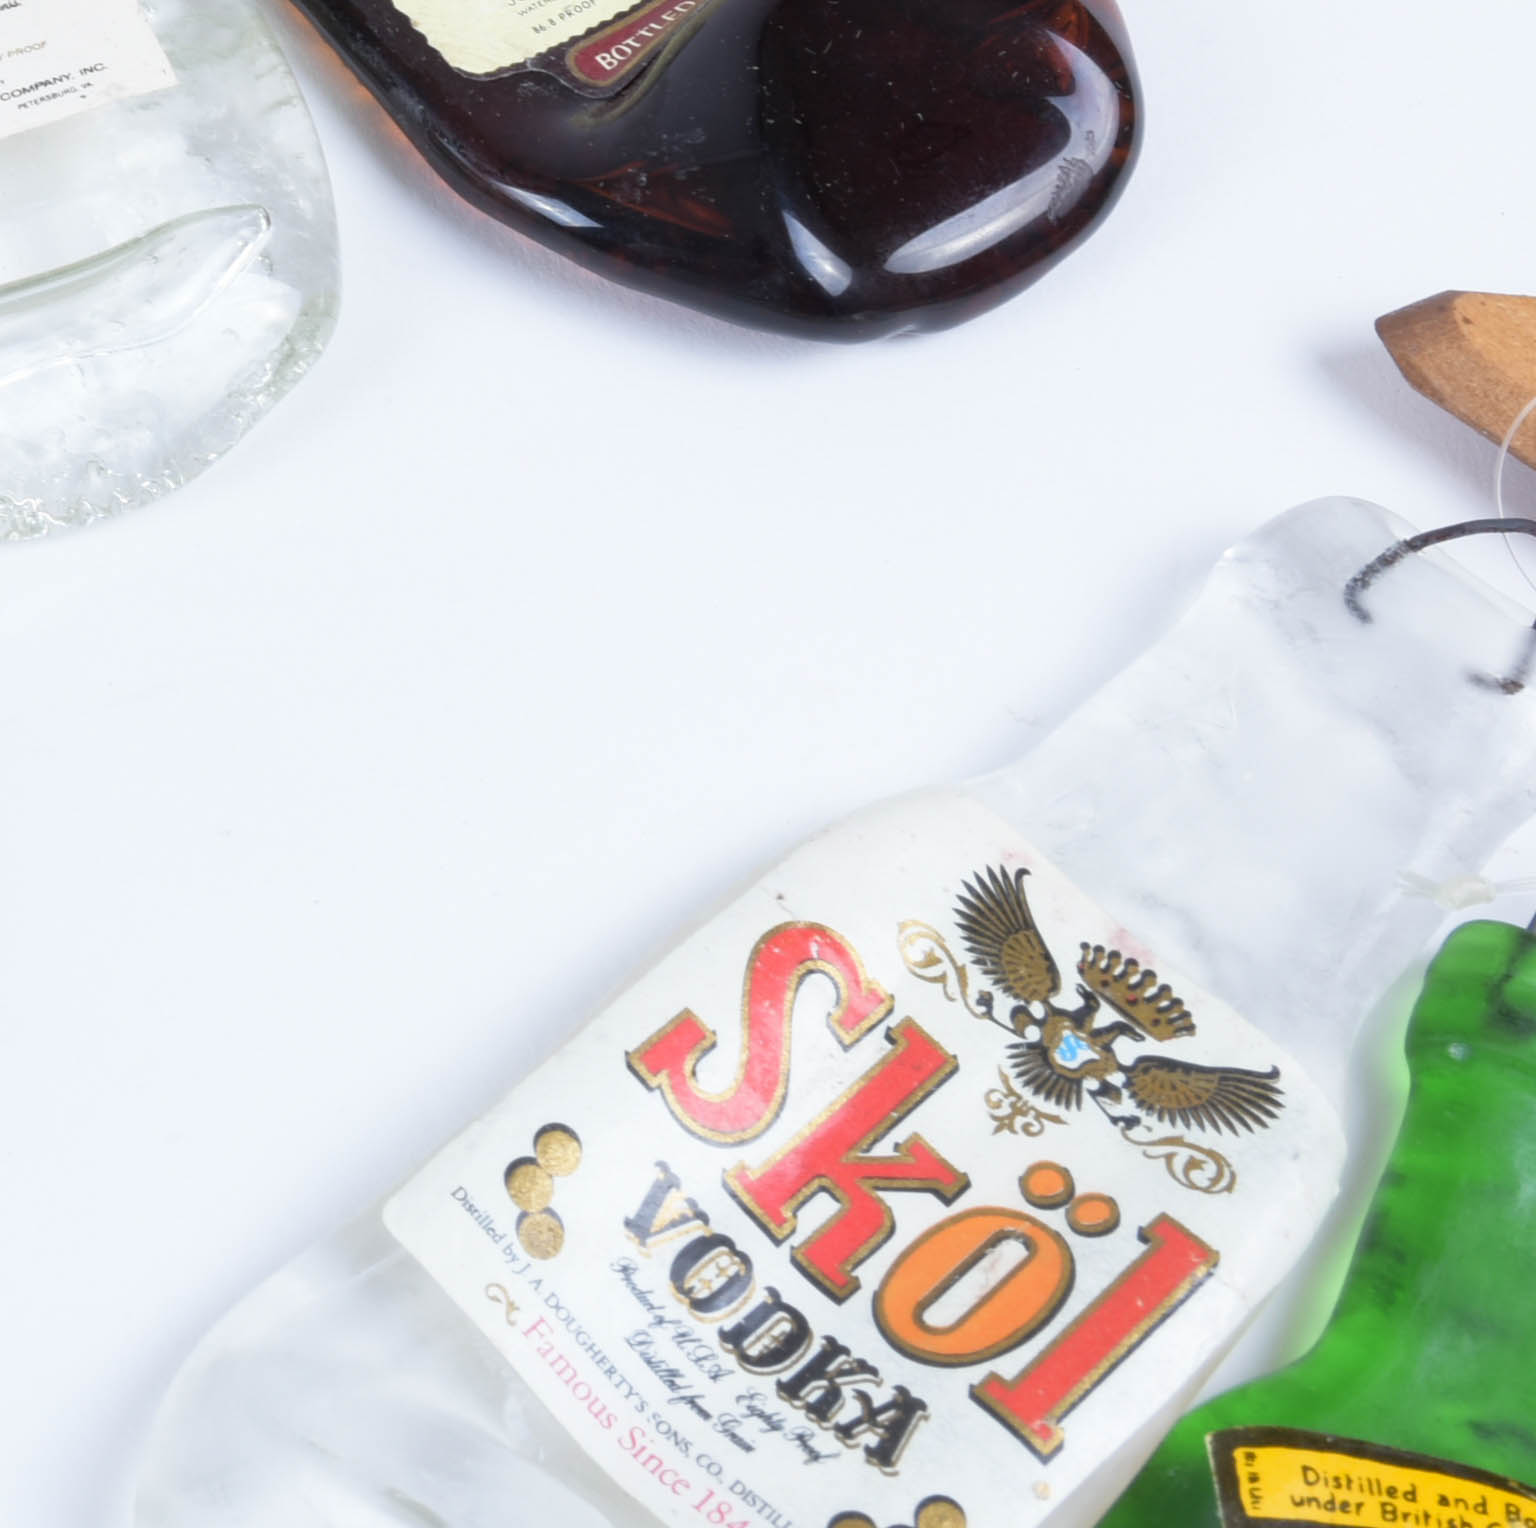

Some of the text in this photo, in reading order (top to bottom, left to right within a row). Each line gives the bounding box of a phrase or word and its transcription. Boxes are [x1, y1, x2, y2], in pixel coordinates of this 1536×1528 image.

[625, 919, 1219, 1463] Sköl
[449, 1185, 506, 1245] Distilled
[501, 1241, 521, 1265] by
[543, 1291, 649, 1414] DOUGHERTY'S
[624, 1160, 929, 1477] VODKA
[521, 1315, 619, 1431] Famous
[617, 1426, 691, 1496] Since
[1290, 1493, 1364, 1517] under
[1300, 1464, 1418, 1504] Distilled
[1437, 1493, 1489, 1516] and
